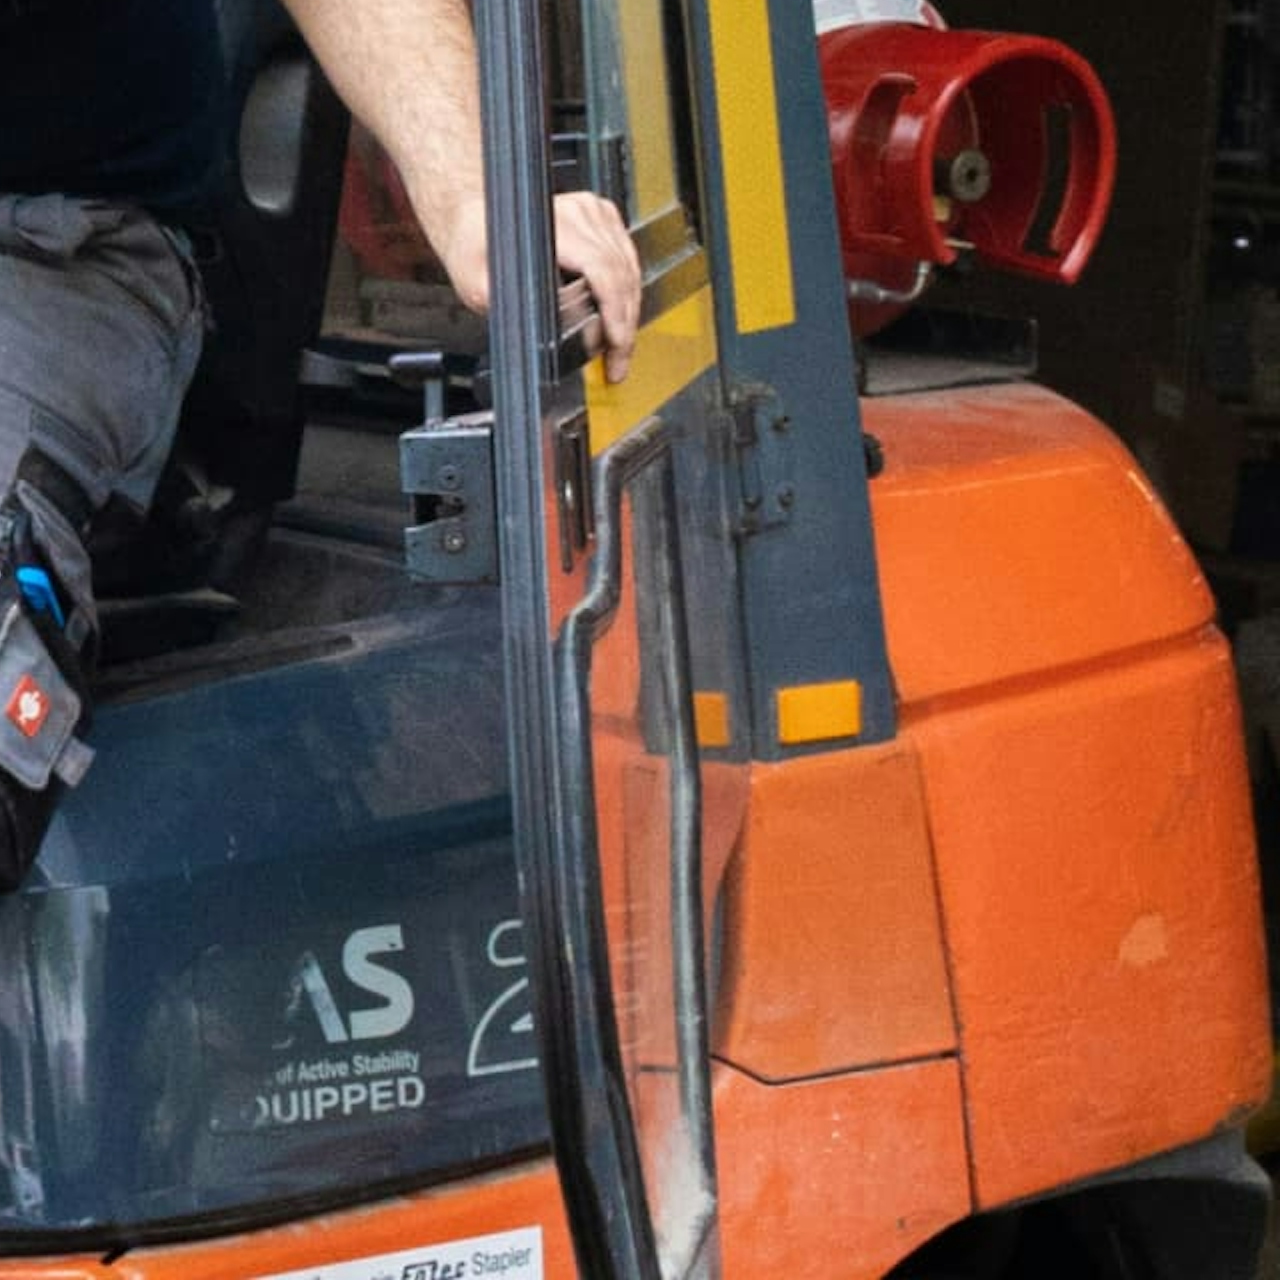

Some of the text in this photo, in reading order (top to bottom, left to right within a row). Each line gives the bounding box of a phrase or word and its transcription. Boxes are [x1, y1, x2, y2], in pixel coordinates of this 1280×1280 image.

[297, 1057, 350, 1082] Active
[351, 1050, 420, 1076] Stability
[471, 1246, 532, 1277] Stapler
